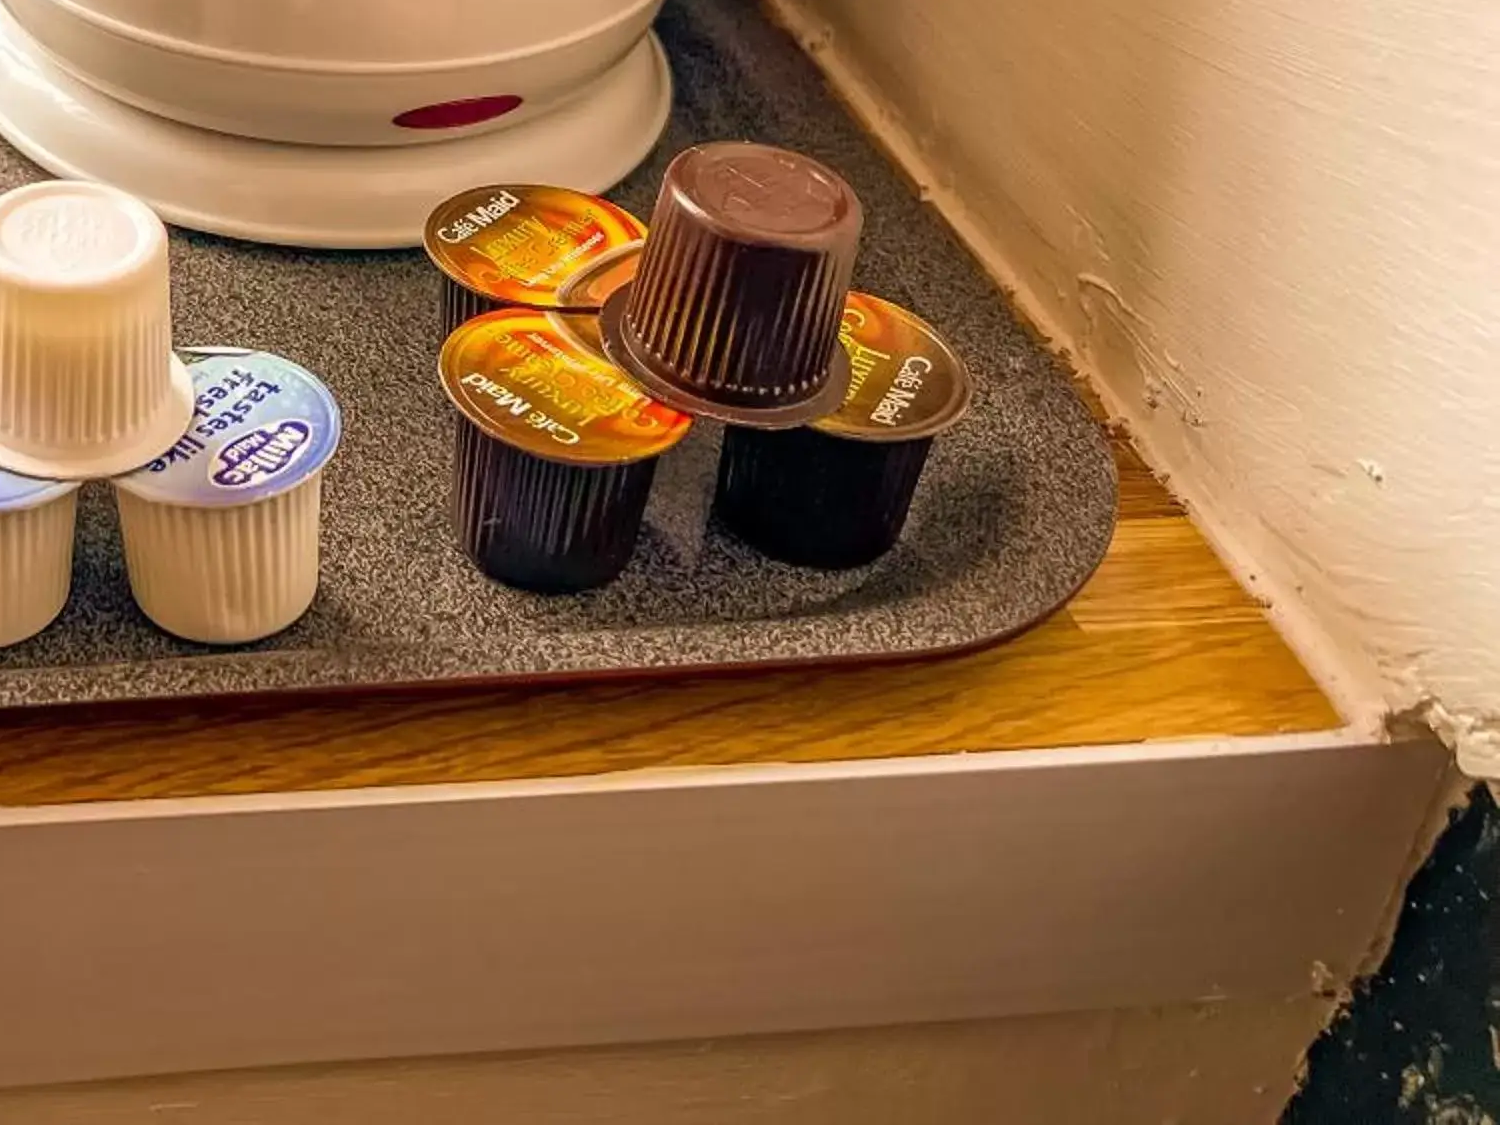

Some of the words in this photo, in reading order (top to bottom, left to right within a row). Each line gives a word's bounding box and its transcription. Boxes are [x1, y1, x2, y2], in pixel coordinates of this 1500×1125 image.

[470, 189, 521, 229] Maid
[894, 356, 933, 390] Café
[196, 381, 282, 437] tastes
[461, 373, 532, 416] Maid
[499, 366, 598, 427] Luxury
[870, 386, 916, 426] Maid
[525, 409, 581, 445] Café
[149, 434, 205, 473] like
[222, 426, 306, 483] Millac
